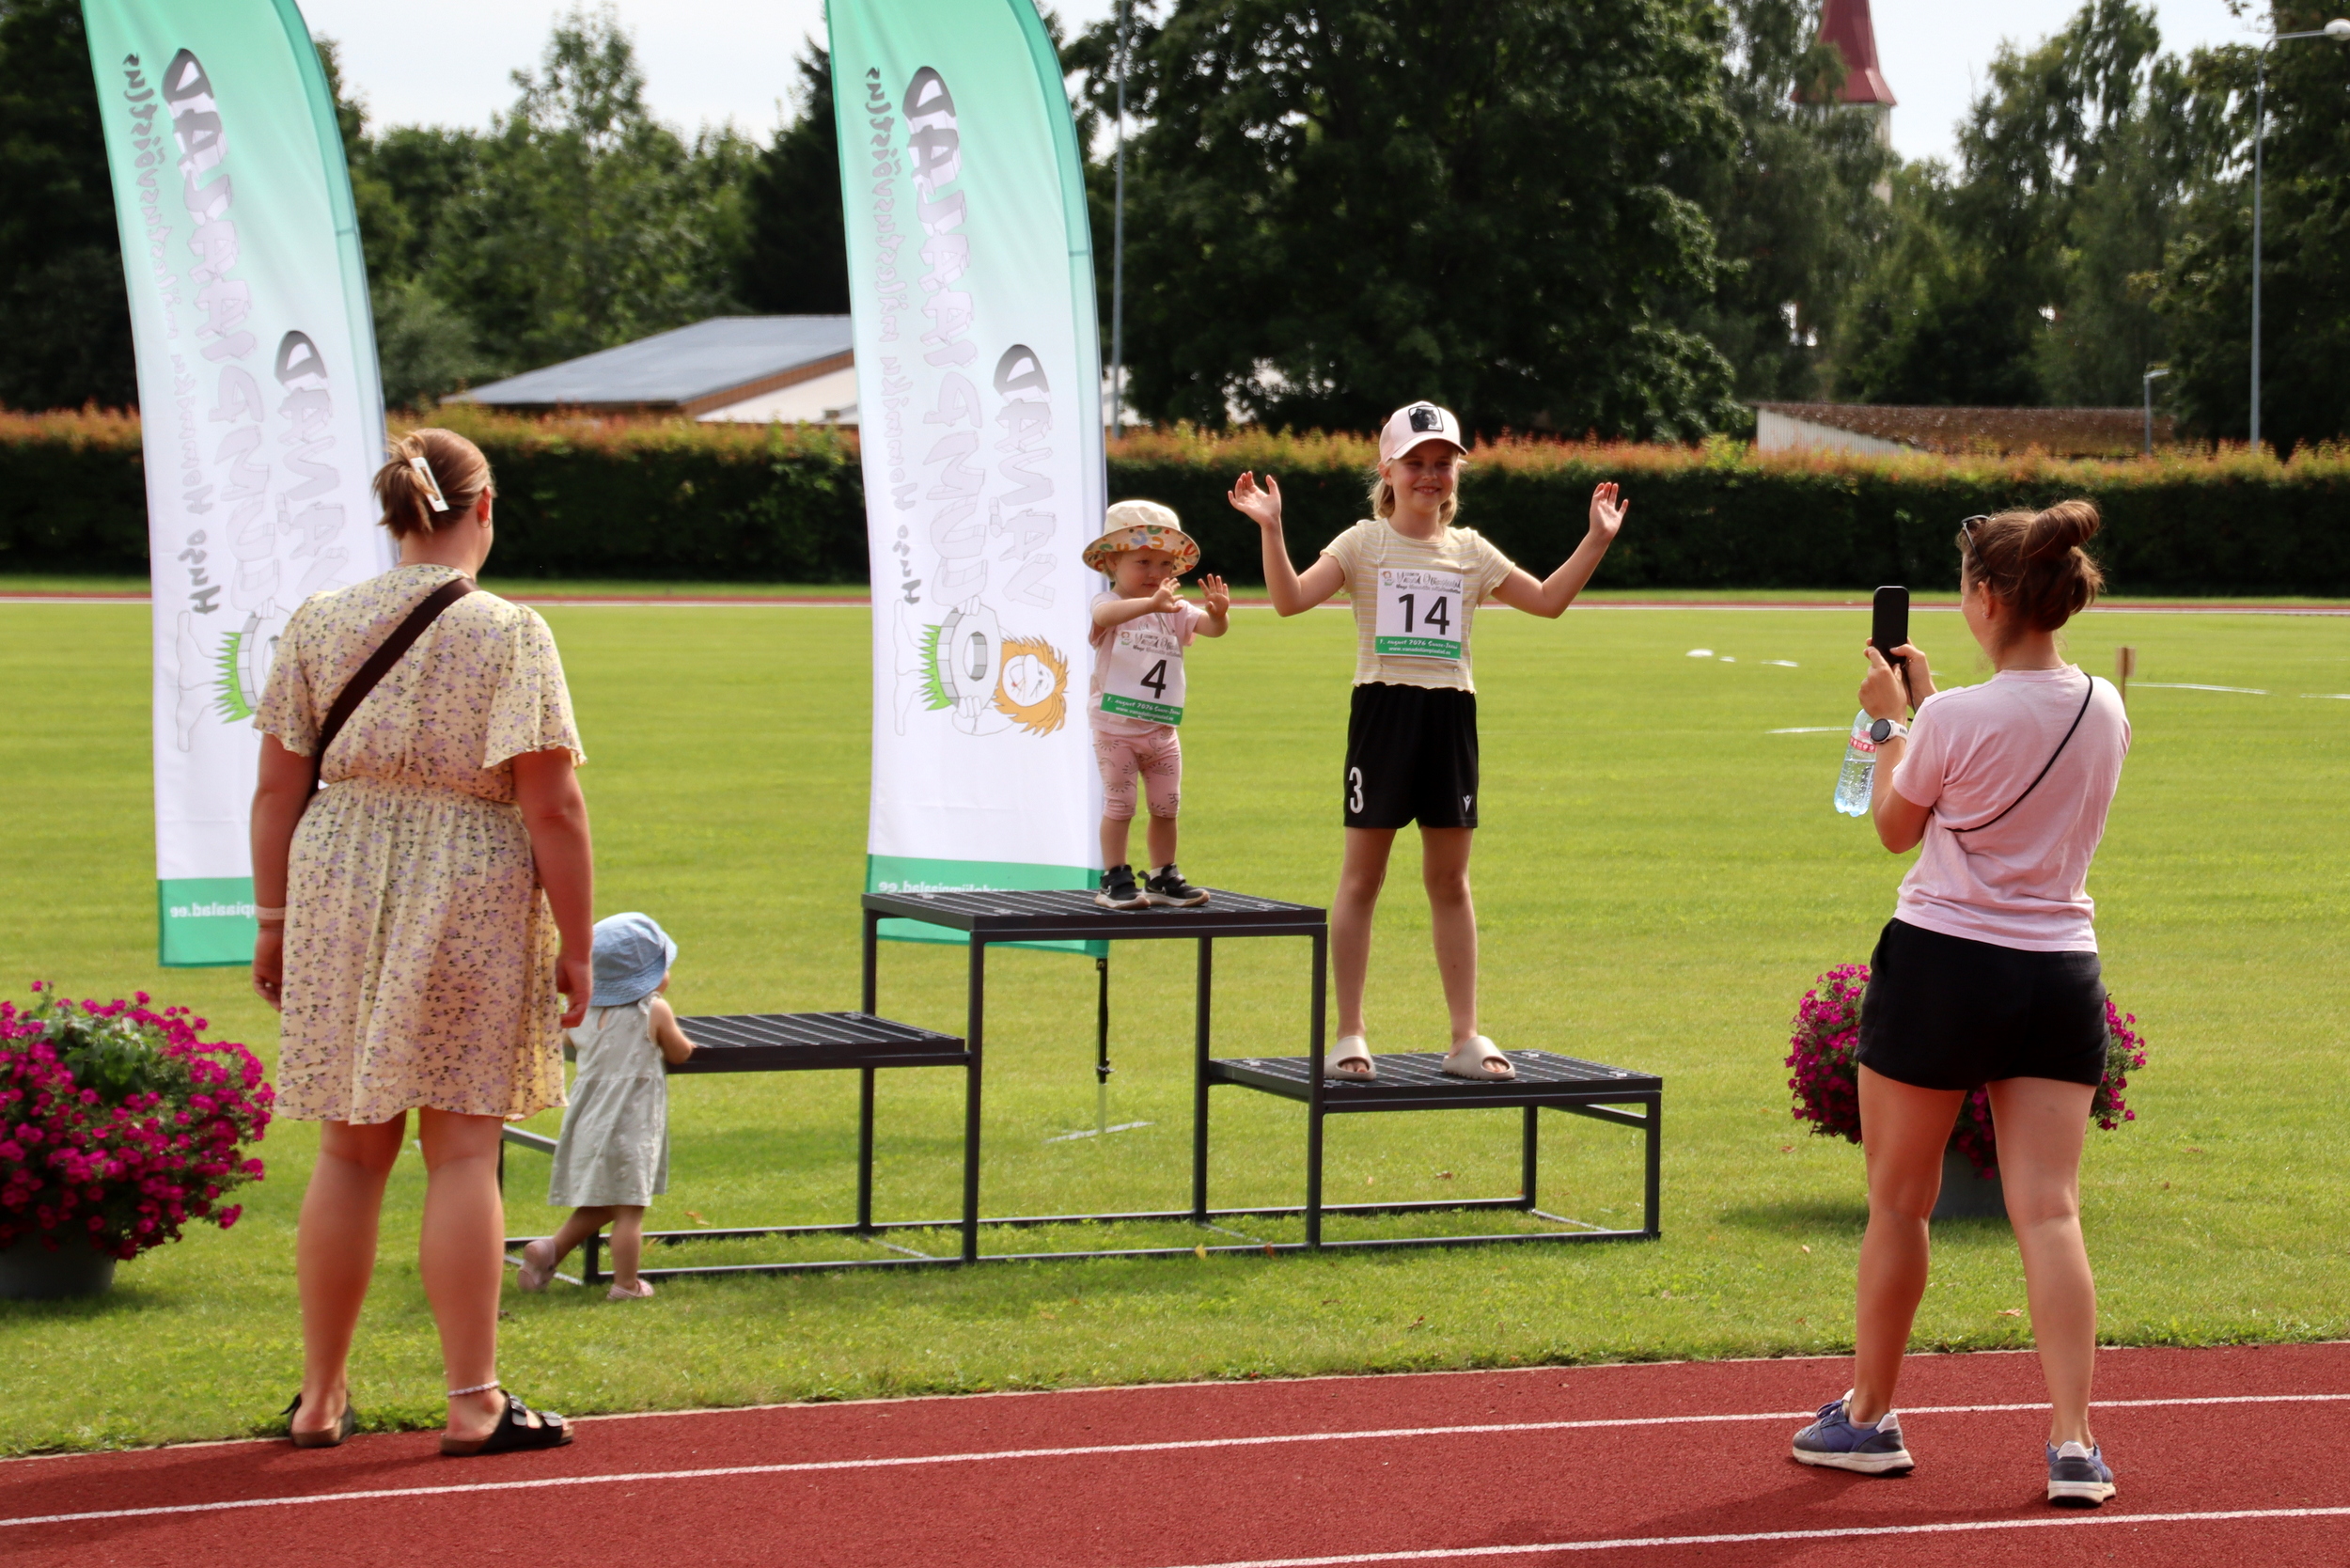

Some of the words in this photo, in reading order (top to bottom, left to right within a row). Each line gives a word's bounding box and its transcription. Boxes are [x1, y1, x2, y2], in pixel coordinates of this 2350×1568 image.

[1399, 593, 1449, 635] 14
[1140, 659, 1167, 699] 4
[1136, 702, 1153, 711] 2026
[1348, 766, 1364, 814] 3
